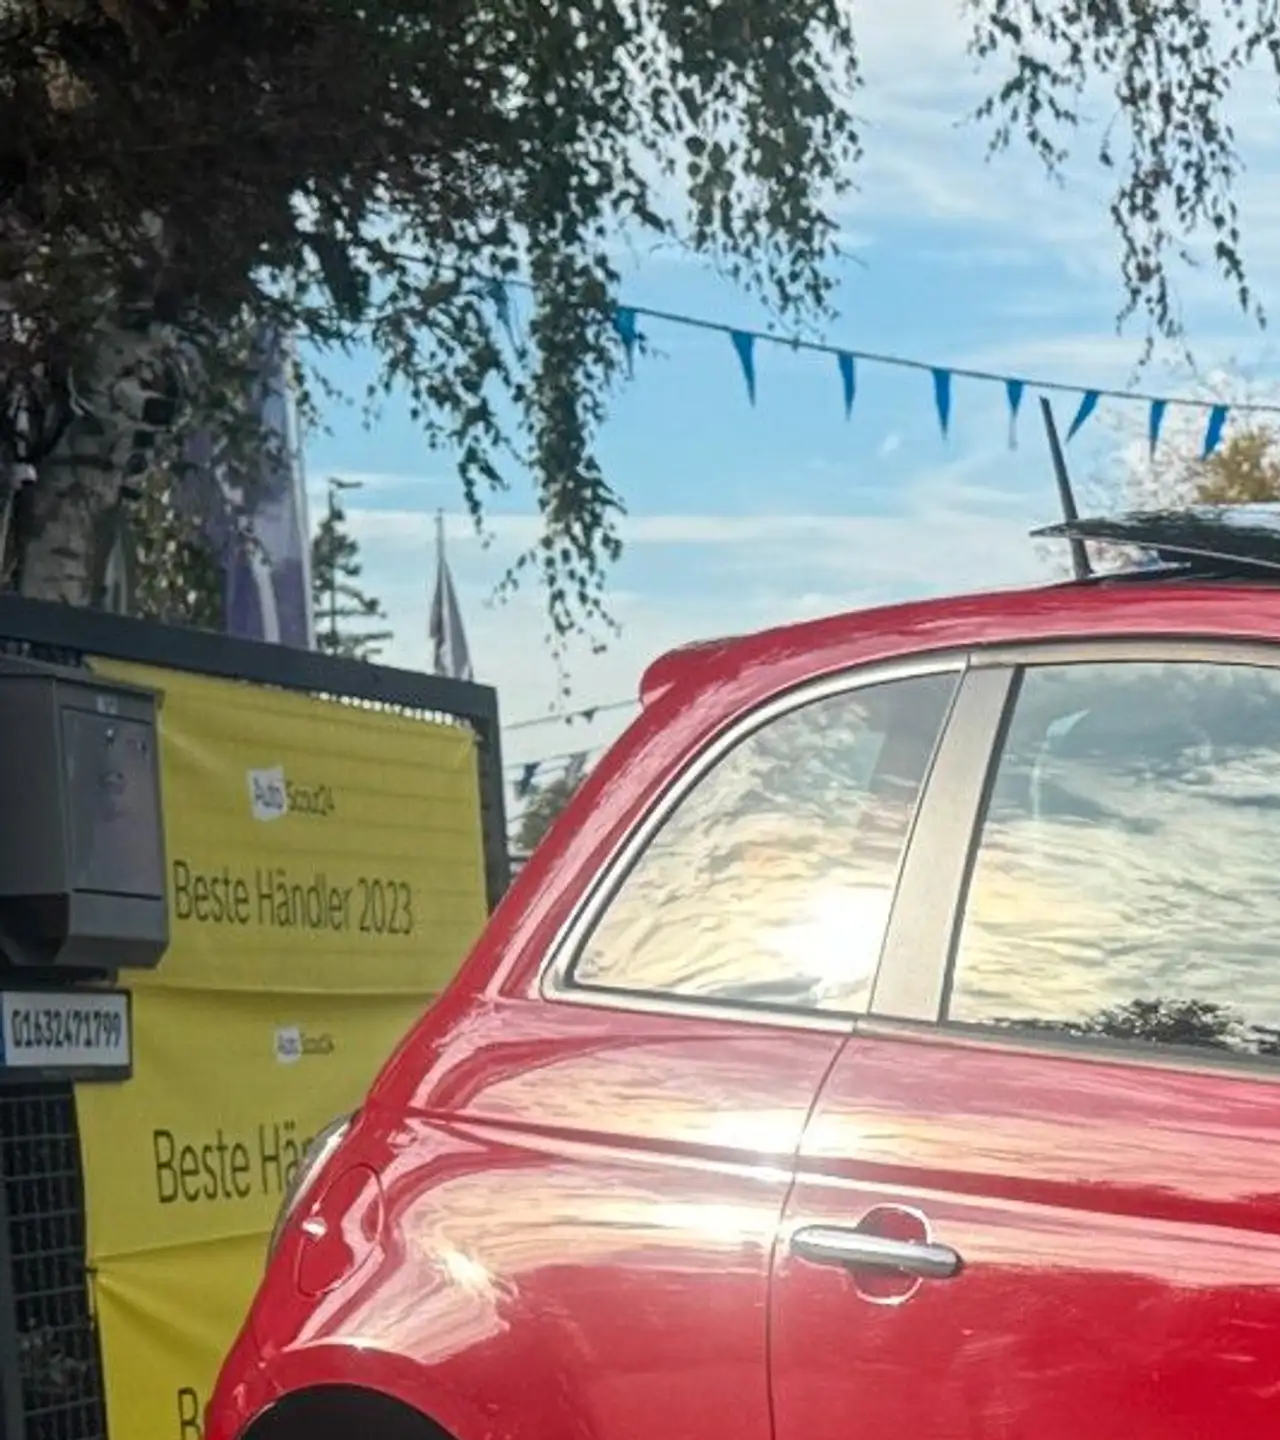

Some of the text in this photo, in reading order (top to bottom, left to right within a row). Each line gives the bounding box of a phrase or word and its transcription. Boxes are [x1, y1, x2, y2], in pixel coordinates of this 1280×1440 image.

[173, 859, 414, 935] Beste Händler 2023
[153, 1128, 251, 1204] Beste
